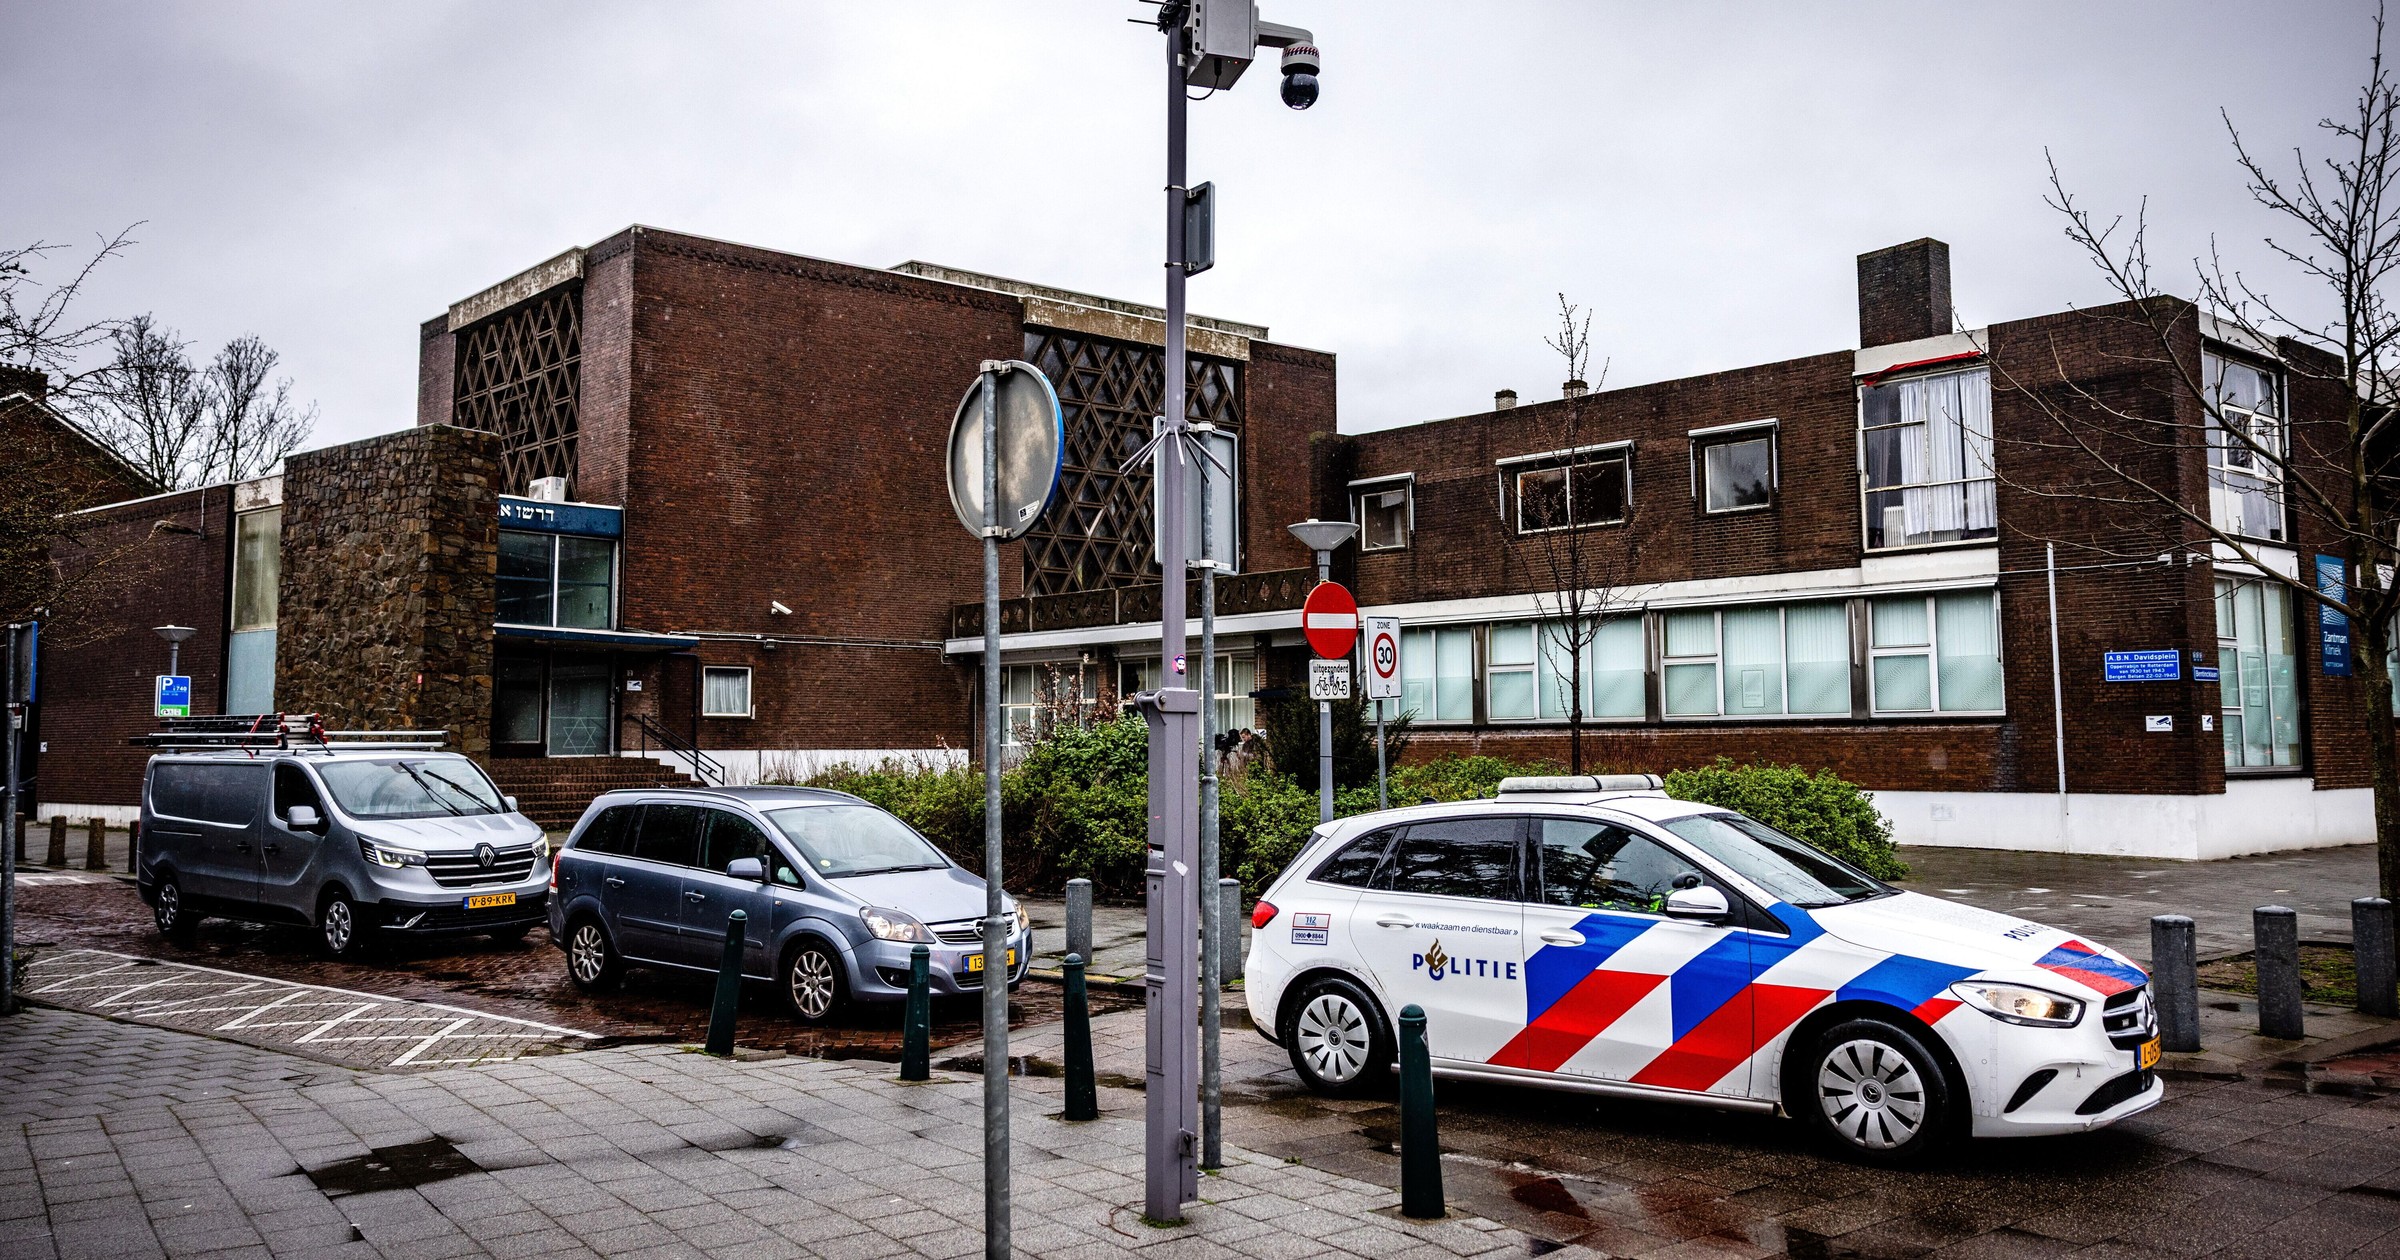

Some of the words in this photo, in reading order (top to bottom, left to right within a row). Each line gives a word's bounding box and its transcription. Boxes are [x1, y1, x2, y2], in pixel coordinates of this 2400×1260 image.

[496, 504, 511, 517] א
[515, 505, 555, 522] דרשו
[1377, 621, 1391, 629] ZONE
[2323, 631, 2348, 644] Zantman
[1378, 646, 1392, 665] 30
[2134, 652, 2176, 661] Davidsplein
[2324, 644, 2342, 656] Kliniek
[1312, 664, 1349, 676] uitgezonderd
[162, 677, 174, 691] P
[471, 894, 514, 907] V-89-KRK
[1306, 916, 1317, 924] 112
[1421, 922, 1460, 931] waakzaam
[1471, 926, 1512, 936] dienstbaar
[1412, 953, 1517, 981] POLITIE
